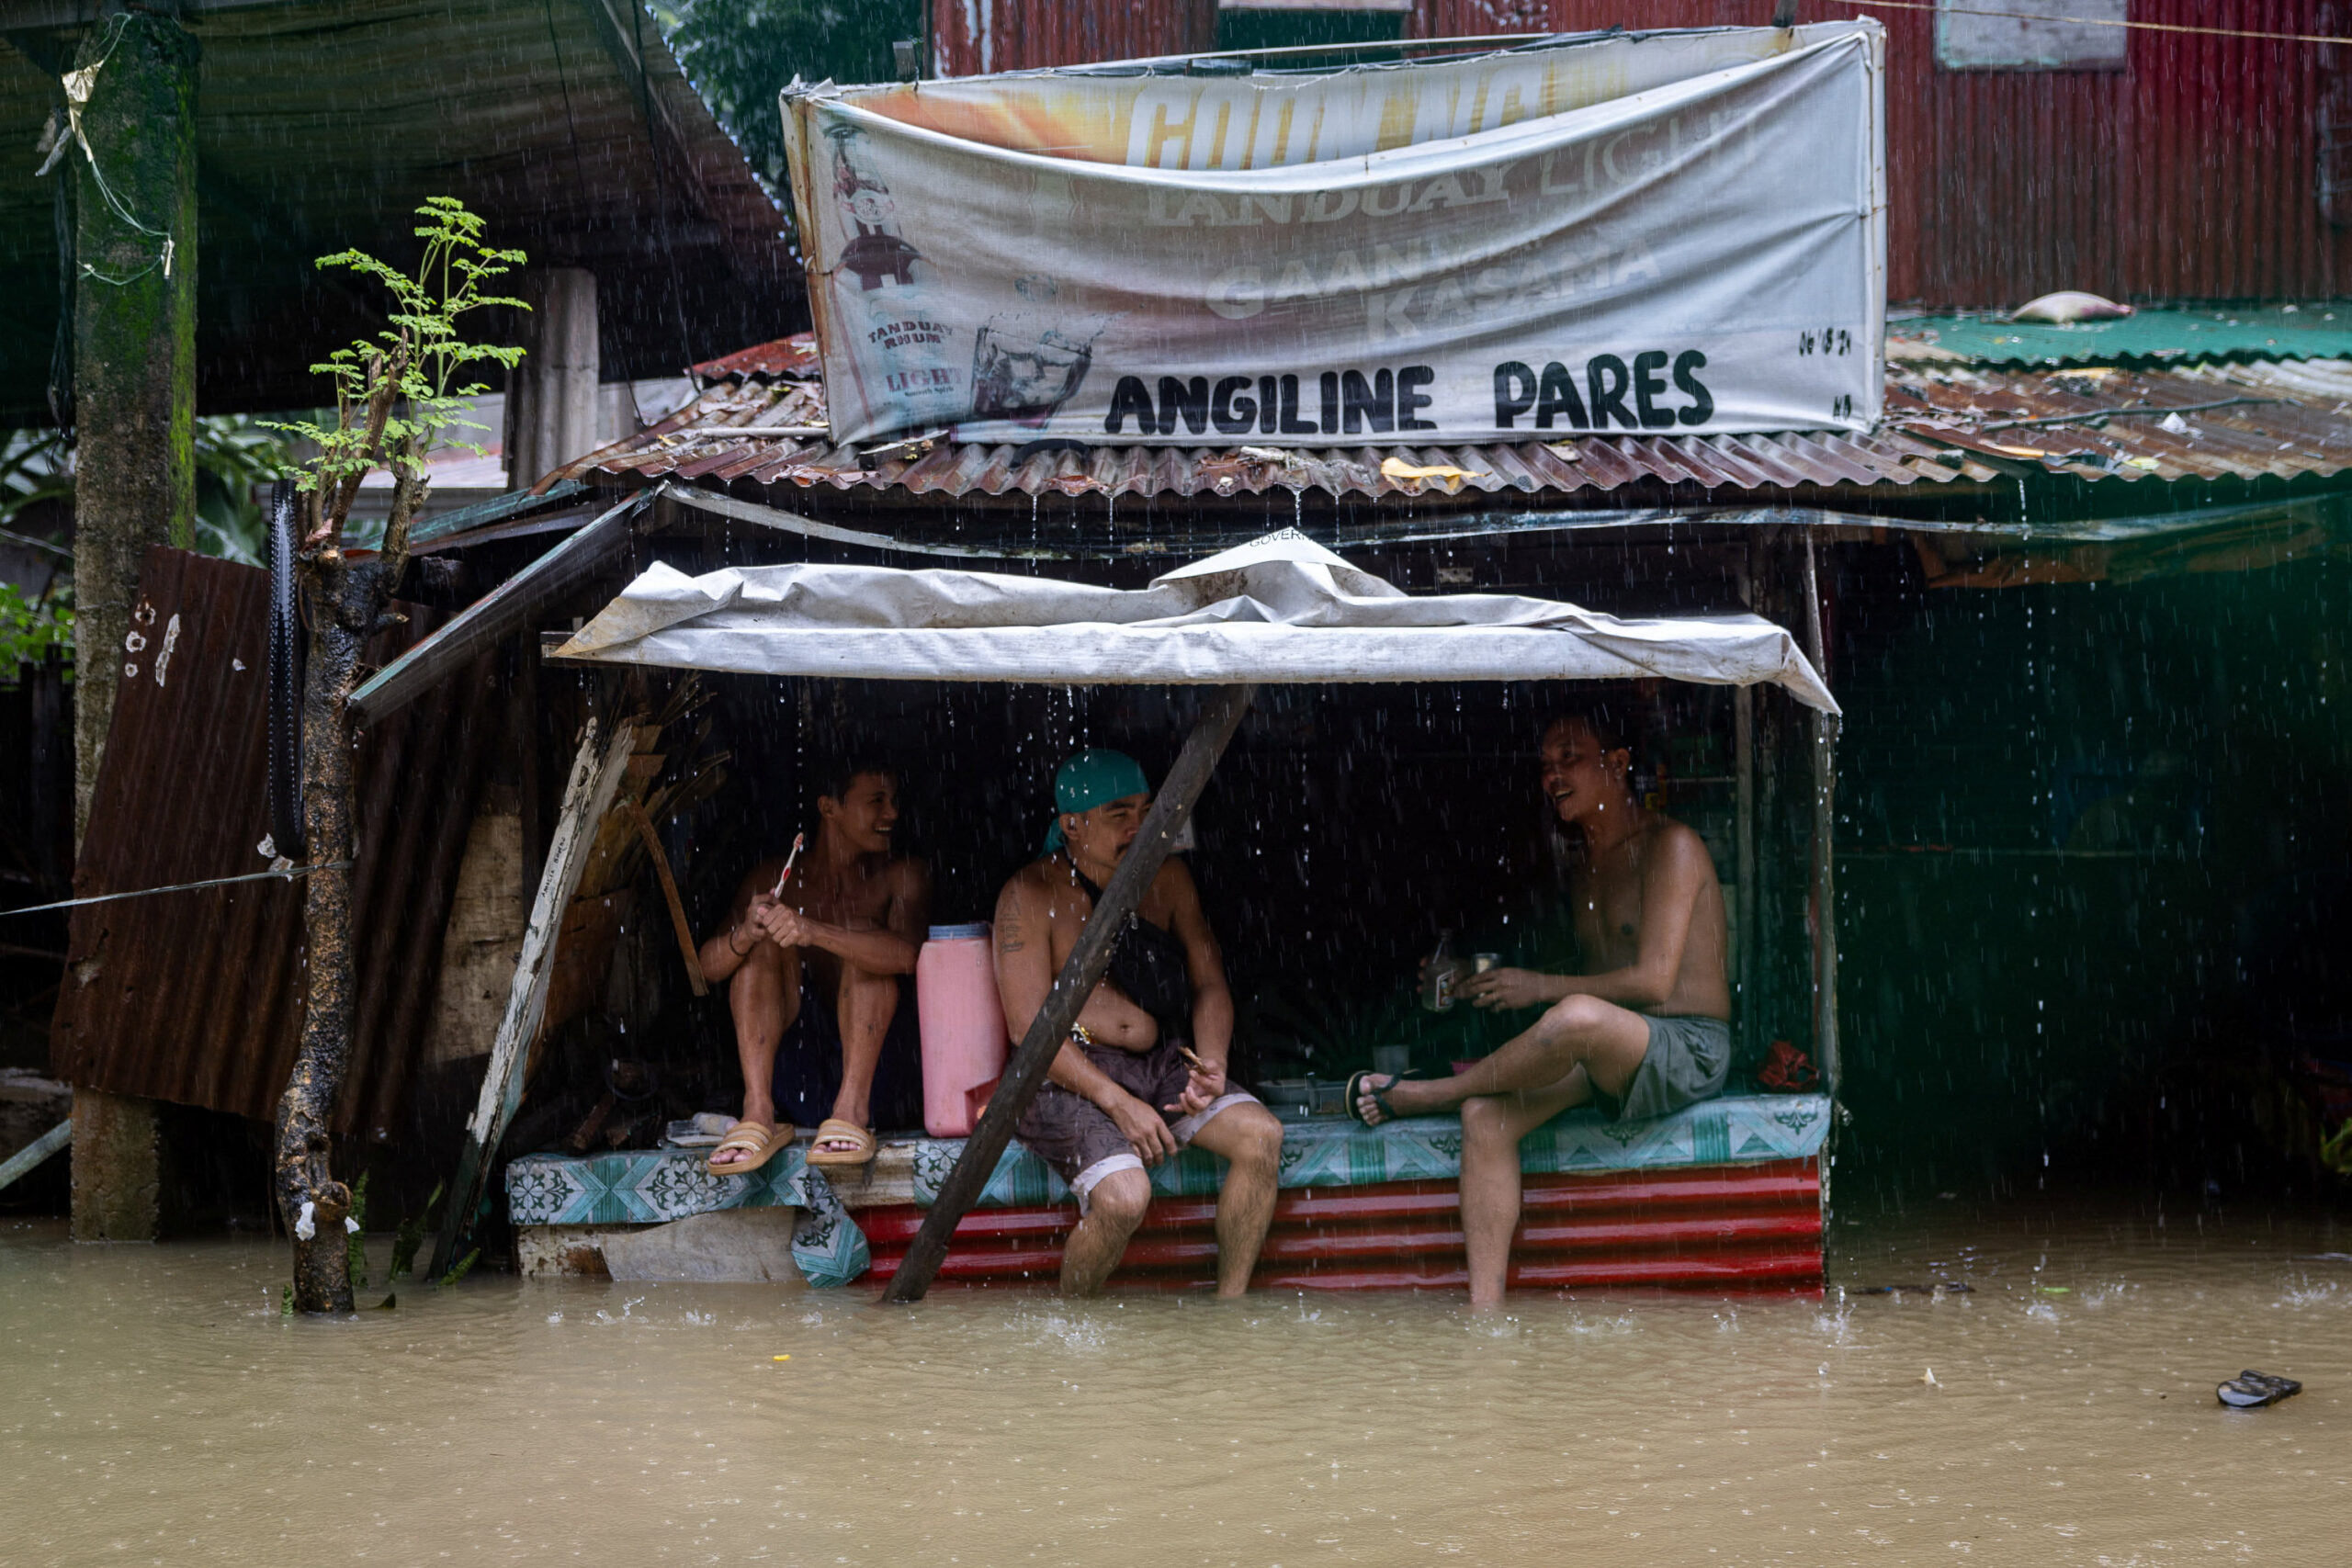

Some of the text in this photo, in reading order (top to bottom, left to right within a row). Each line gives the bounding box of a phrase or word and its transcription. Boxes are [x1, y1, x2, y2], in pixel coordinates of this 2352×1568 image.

[868, 321, 953, 344] TANDUAY
[884, 333, 942, 349] RHUM
[886, 368, 963, 393] LIGHT
[1104, 350, 1714, 435] ANGILINE PARES
[1250, 529, 1306, 547] GOVER
